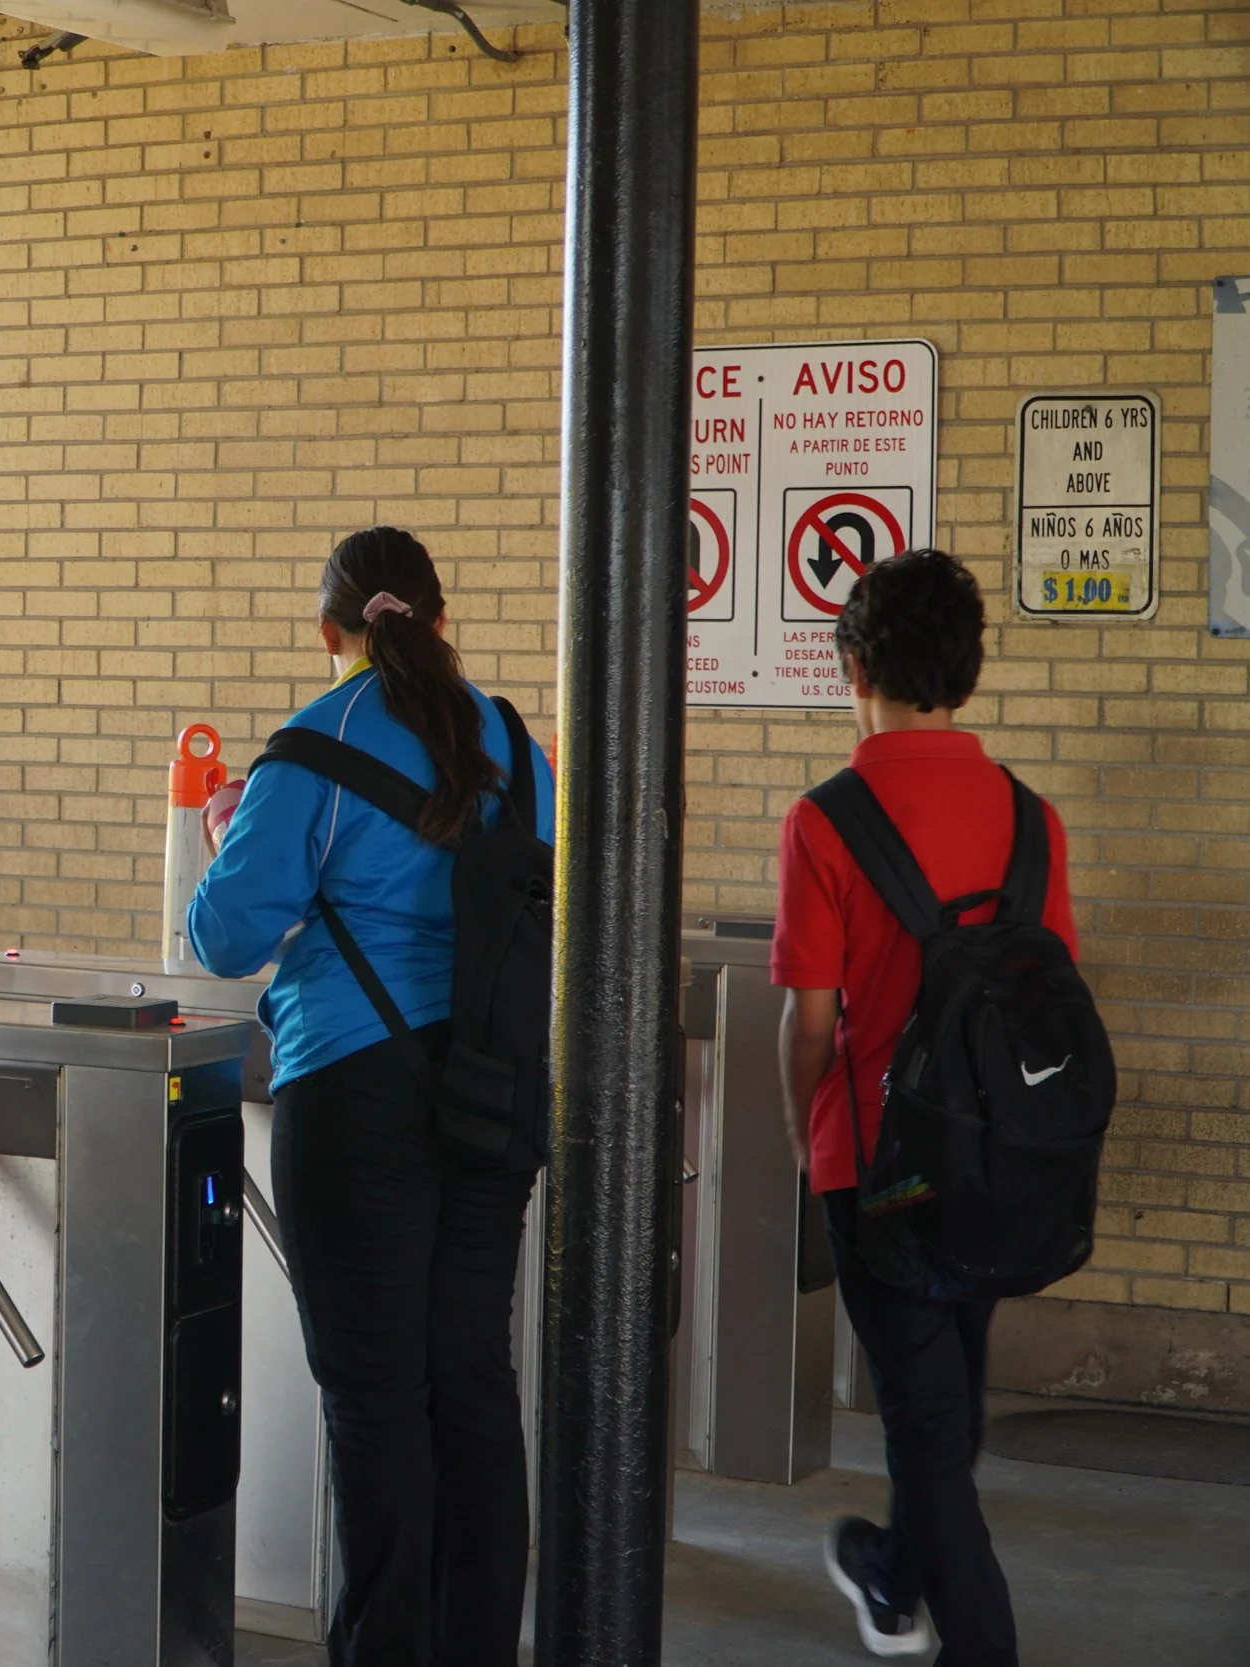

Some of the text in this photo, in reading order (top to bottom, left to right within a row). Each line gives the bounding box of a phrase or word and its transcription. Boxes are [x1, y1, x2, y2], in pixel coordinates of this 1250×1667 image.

[792, 359, 906, 396] AVISO
[773, 409, 924, 430] NO HAY RETORNO
[1031, 407, 1148, 430] CHILDREN 6 YRS
[694, 417, 746, 444] URN
[789, 437, 907, 454] A PARTIR DE ESTE
[1072, 440, 1104, 462] AND
[705, 453, 751, 475] POINT
[825, 461, 869, 476] PUNTO
[1066, 472, 1111, 493] ABOVE
[1031, 512, 1143, 538] NIÑOS 6 AÑOS
[1079, 549, 1110, 570] MAS
[783, 631, 807, 643] LAS
[686, 657, 719, 671] CEED
[785, 649, 834, 661] DESEAN
[774, 666, 809, 678] TIENE
[813, 667, 839, 679] QUE
[686, 681, 746, 694] CUSTOMS
[801, 685, 823, 696] U.S.
